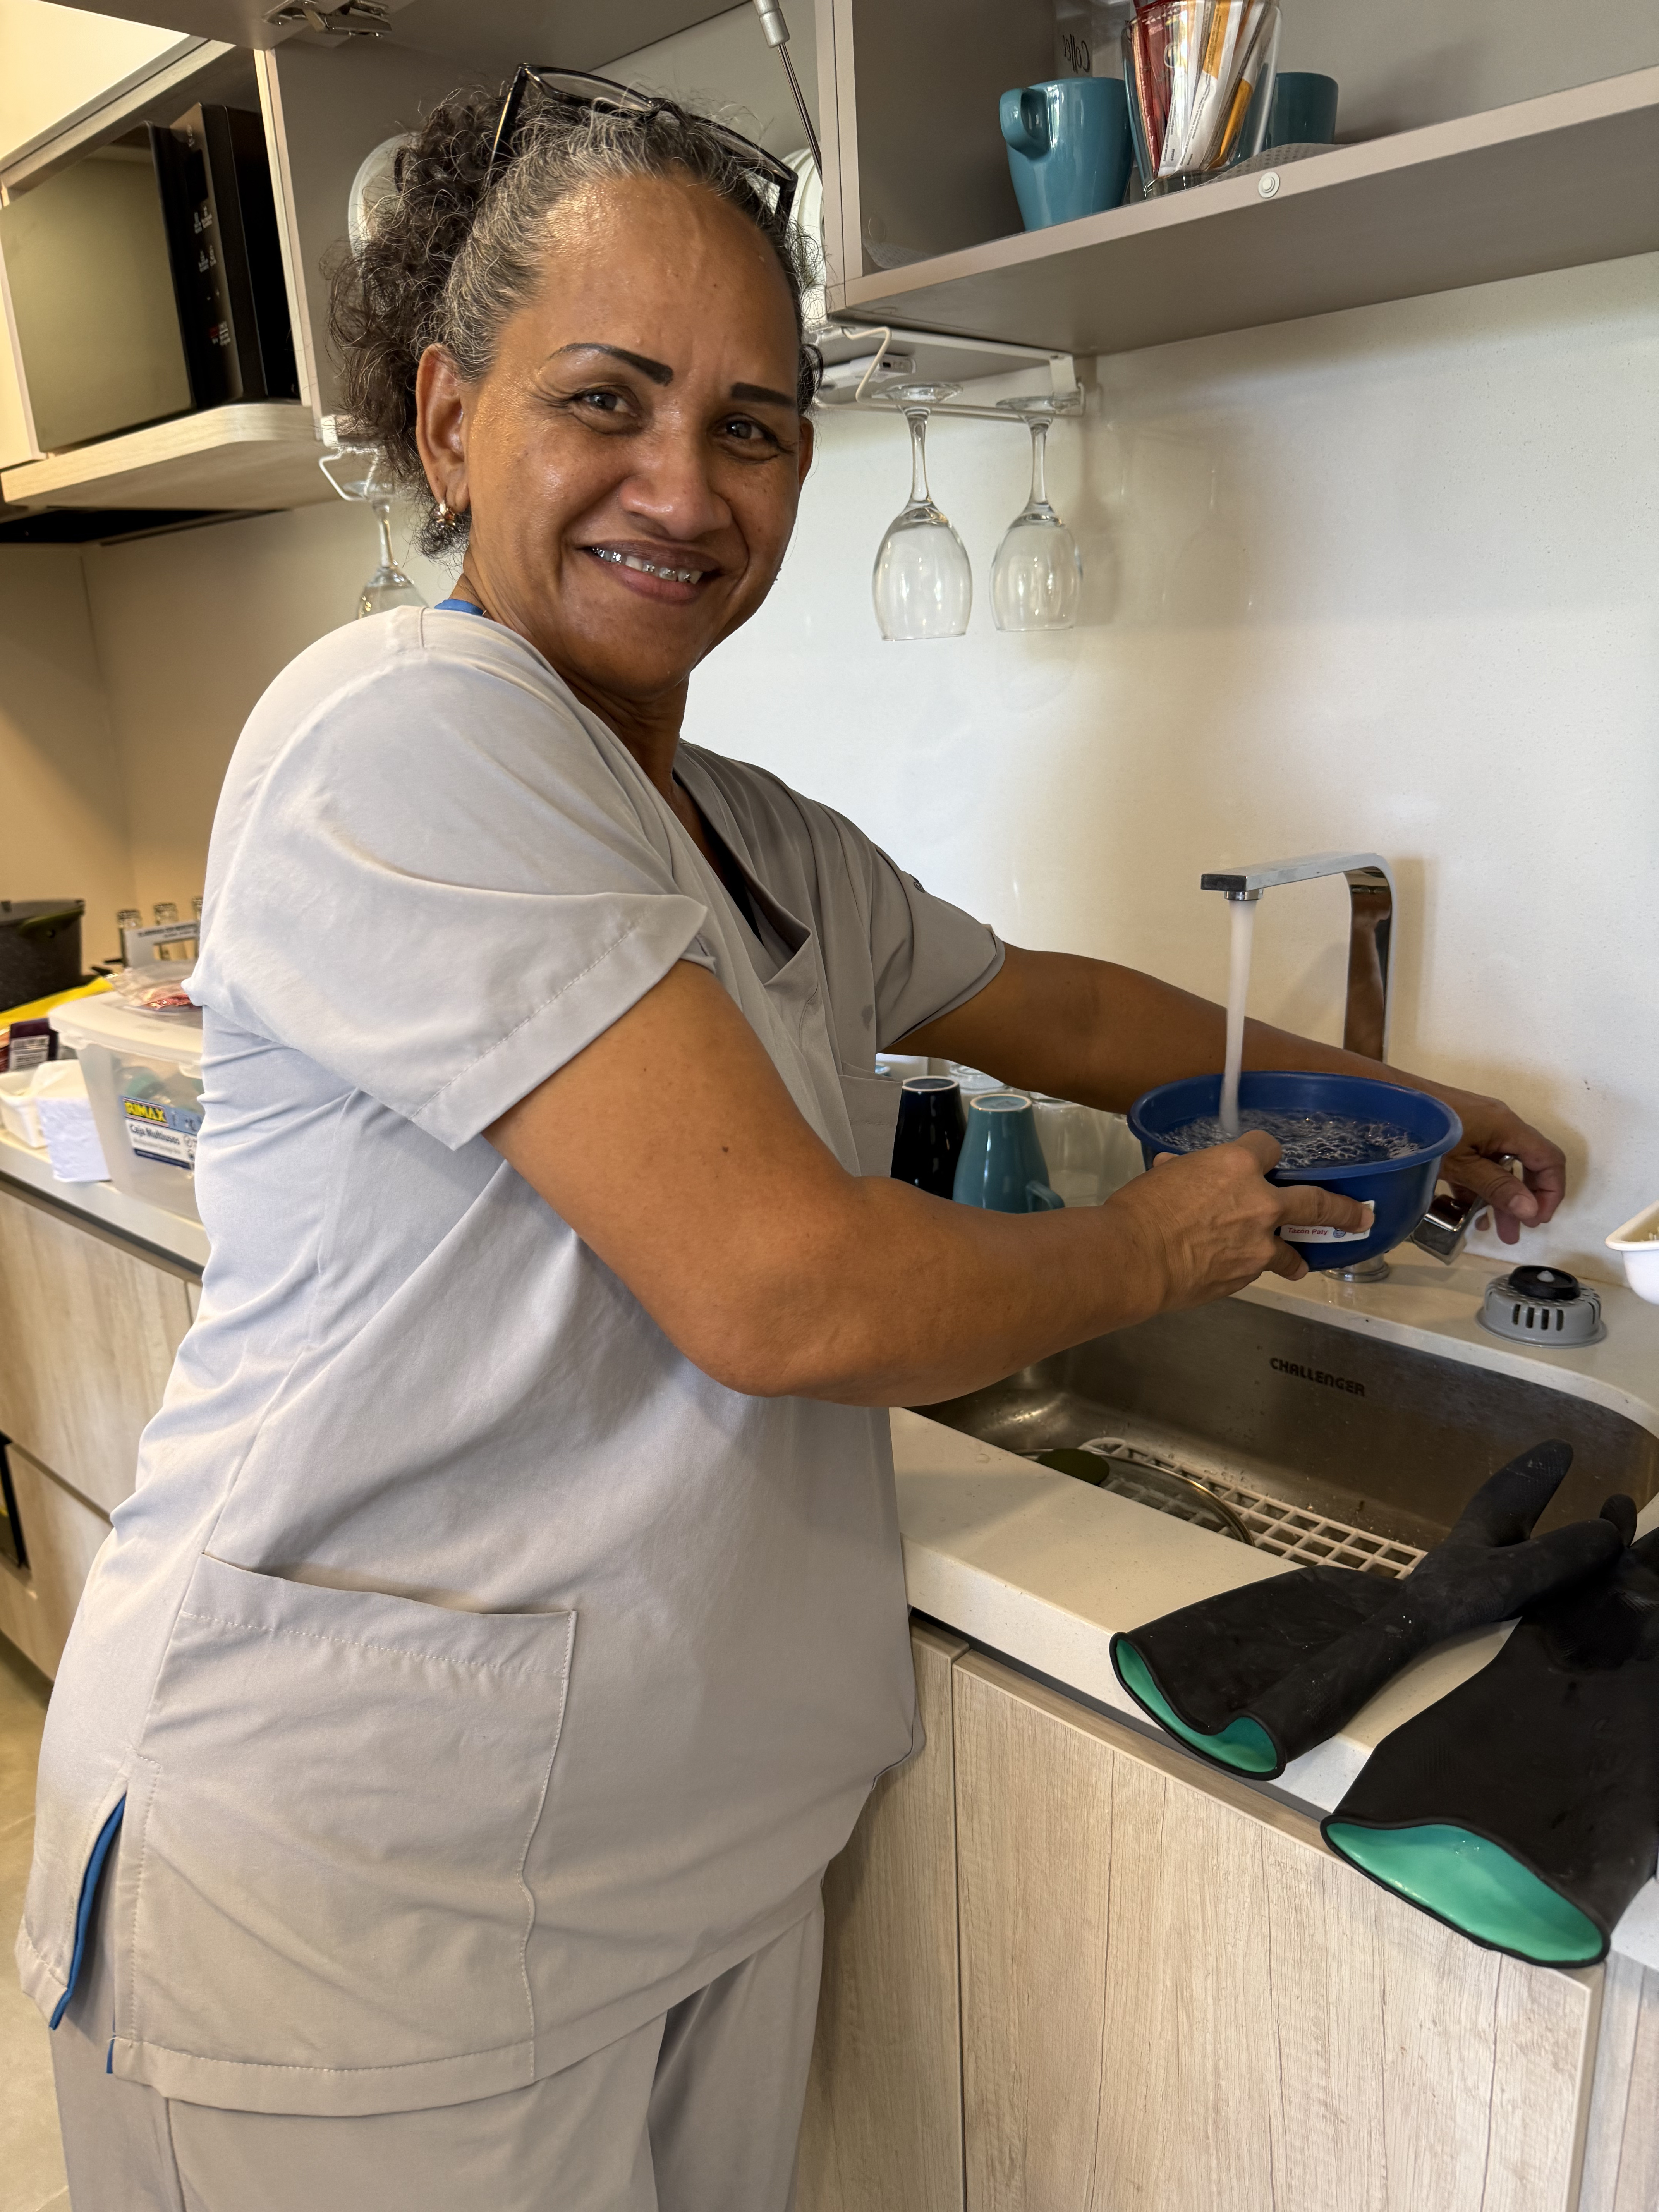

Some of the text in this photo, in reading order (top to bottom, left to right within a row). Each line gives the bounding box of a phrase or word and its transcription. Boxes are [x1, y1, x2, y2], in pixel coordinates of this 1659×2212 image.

[125, 1101, 167, 1123] RIMAX
[129, 1124, 146, 1137] Caja
[1269, 1357, 1365, 1397] CHALLENGER
